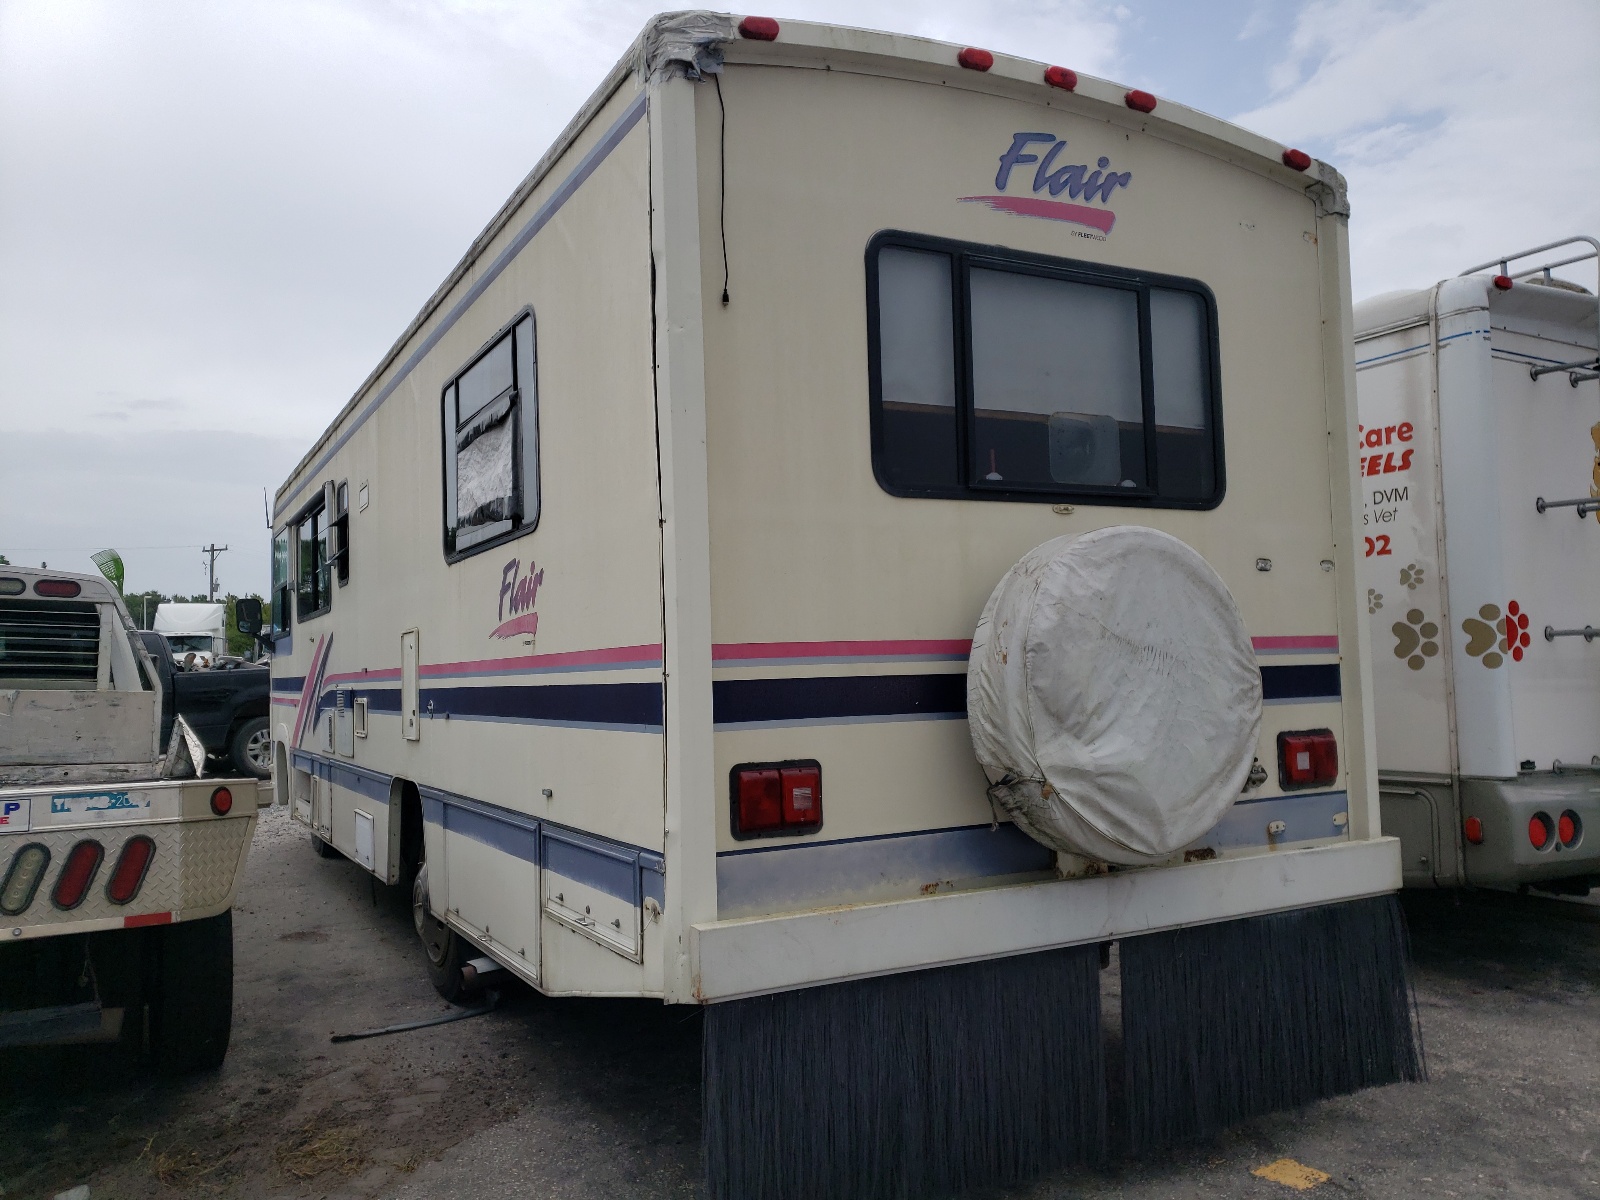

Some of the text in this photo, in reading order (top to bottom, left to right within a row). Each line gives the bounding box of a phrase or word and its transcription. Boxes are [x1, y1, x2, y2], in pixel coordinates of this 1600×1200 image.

[995, 132, 1132, 204] Flair
[1373, 486, 1409, 506] DVM
[1373, 506, 1399, 524] Vet
[498, 557, 545, 623] Flair
